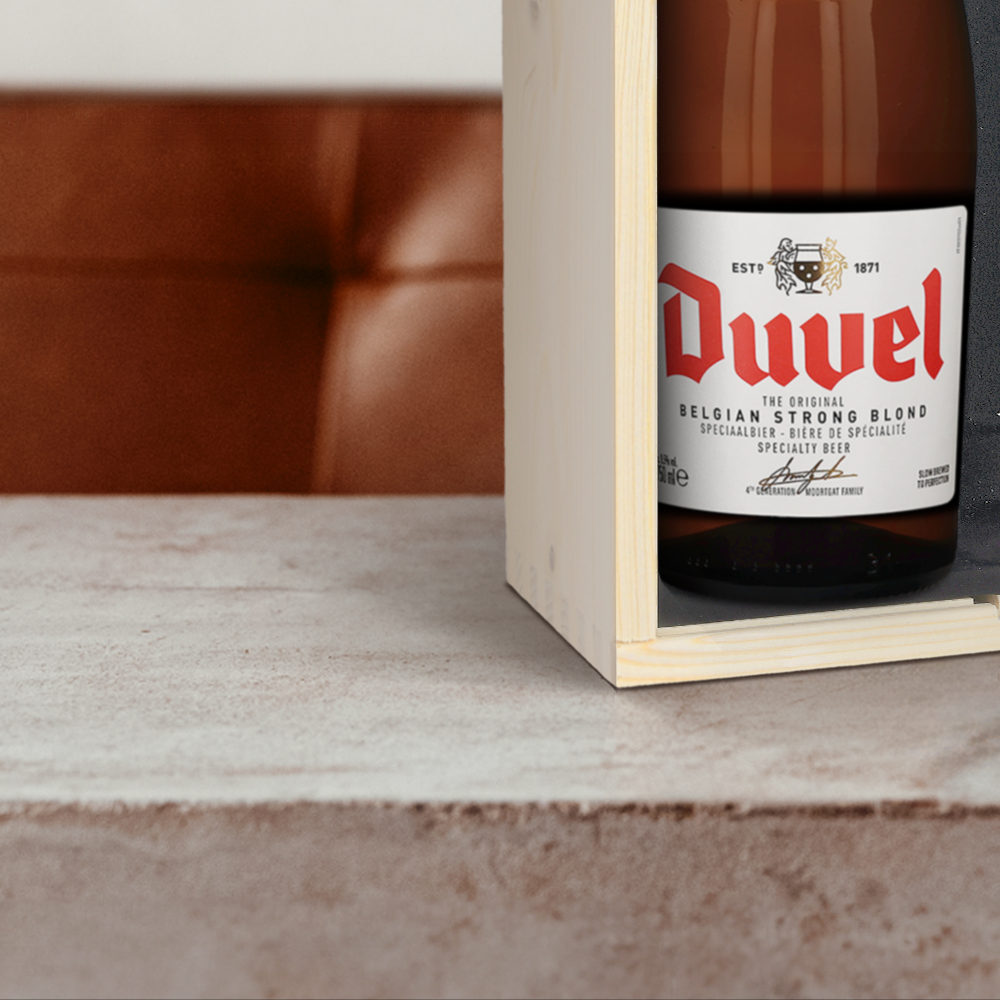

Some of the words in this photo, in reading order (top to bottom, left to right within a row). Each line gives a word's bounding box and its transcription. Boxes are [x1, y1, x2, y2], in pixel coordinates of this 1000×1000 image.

[853, 261, 880, 274] 1871
[658, 262, 944, 391] Duvel
[762, 395, 783, 407] THE
[789, 395, 845, 408] ORIGINAL
[679, 403, 760, 423] BELGIAN
[774, 410, 858, 425] STRONG
[870, 404, 927, 423] BLOND
[700, 422, 776, 439] SPECIAALBIER
[789, 426, 823, 439] BIÈRE
[828, 427, 842, 439] DE
[847, 422, 907, 439] SPÉCIALITÉ
[757, 441, 818, 454] SPECIALTY
[822, 441, 851, 454] BEER
[756, 486, 796, 496] GENERATION
[841, 486, 864, 496] FAMILY
